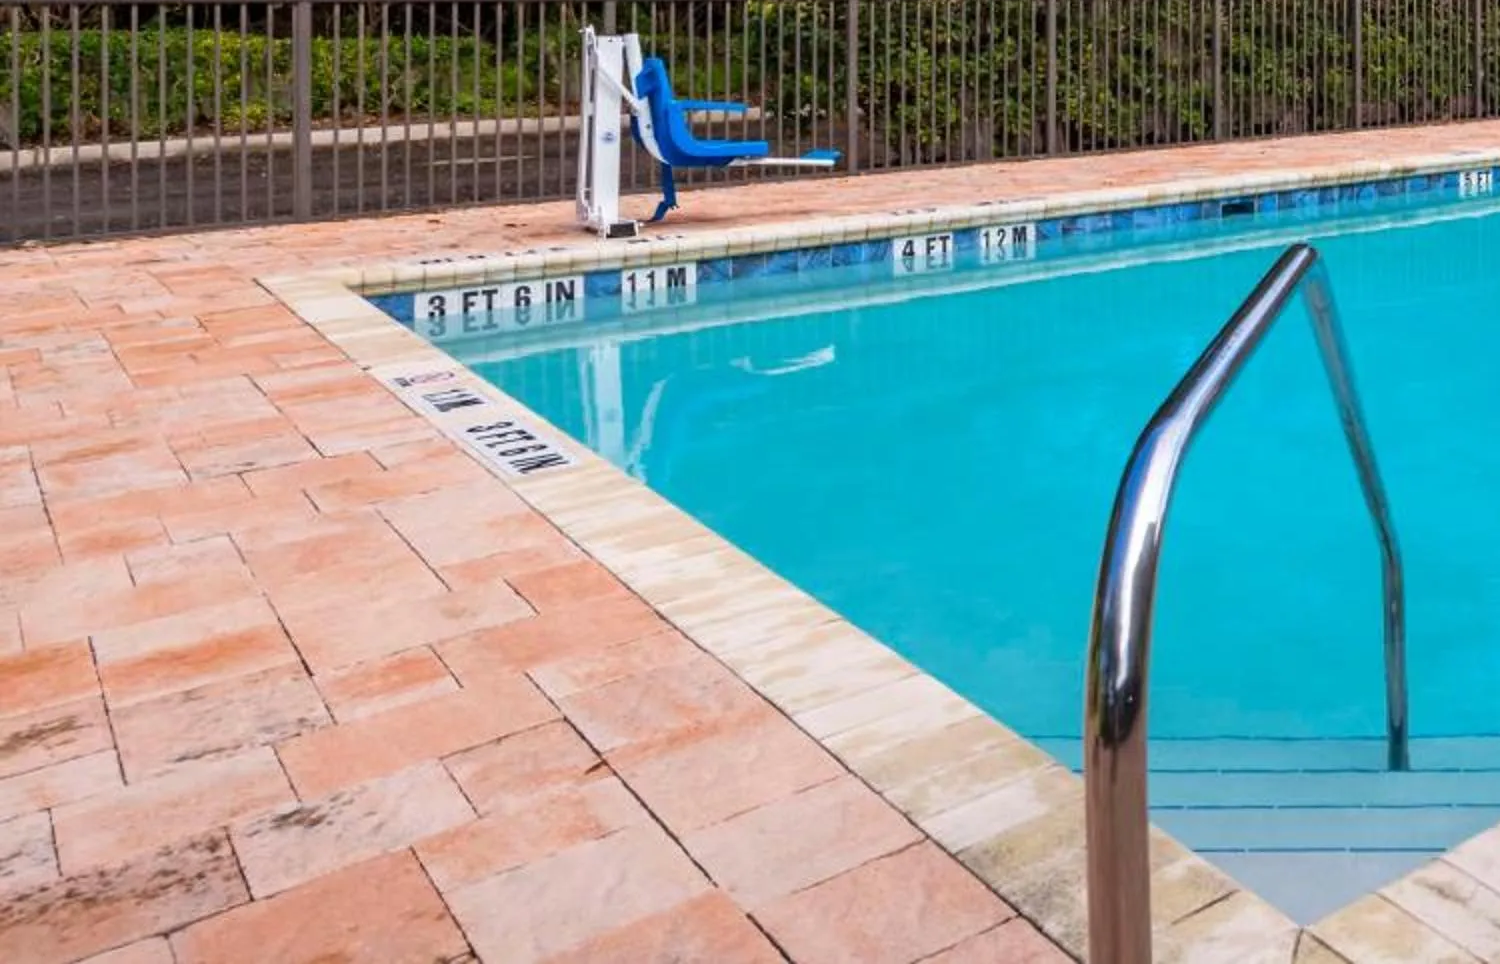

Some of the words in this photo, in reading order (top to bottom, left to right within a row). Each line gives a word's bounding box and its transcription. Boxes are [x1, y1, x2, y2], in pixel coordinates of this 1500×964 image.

[902, 239, 915, 256] 4
[926, 235, 951, 255] FT
[428, 295, 446, 317] 3
[463, 289, 498, 314] FT
[514, 286, 531, 307] 6
[546, 279, 575, 302] IN
[466, 420, 514, 433] 3
[475, 429, 537, 448] FT
[498, 443, 548, 457] 6
[509, 452, 570, 474] IN
